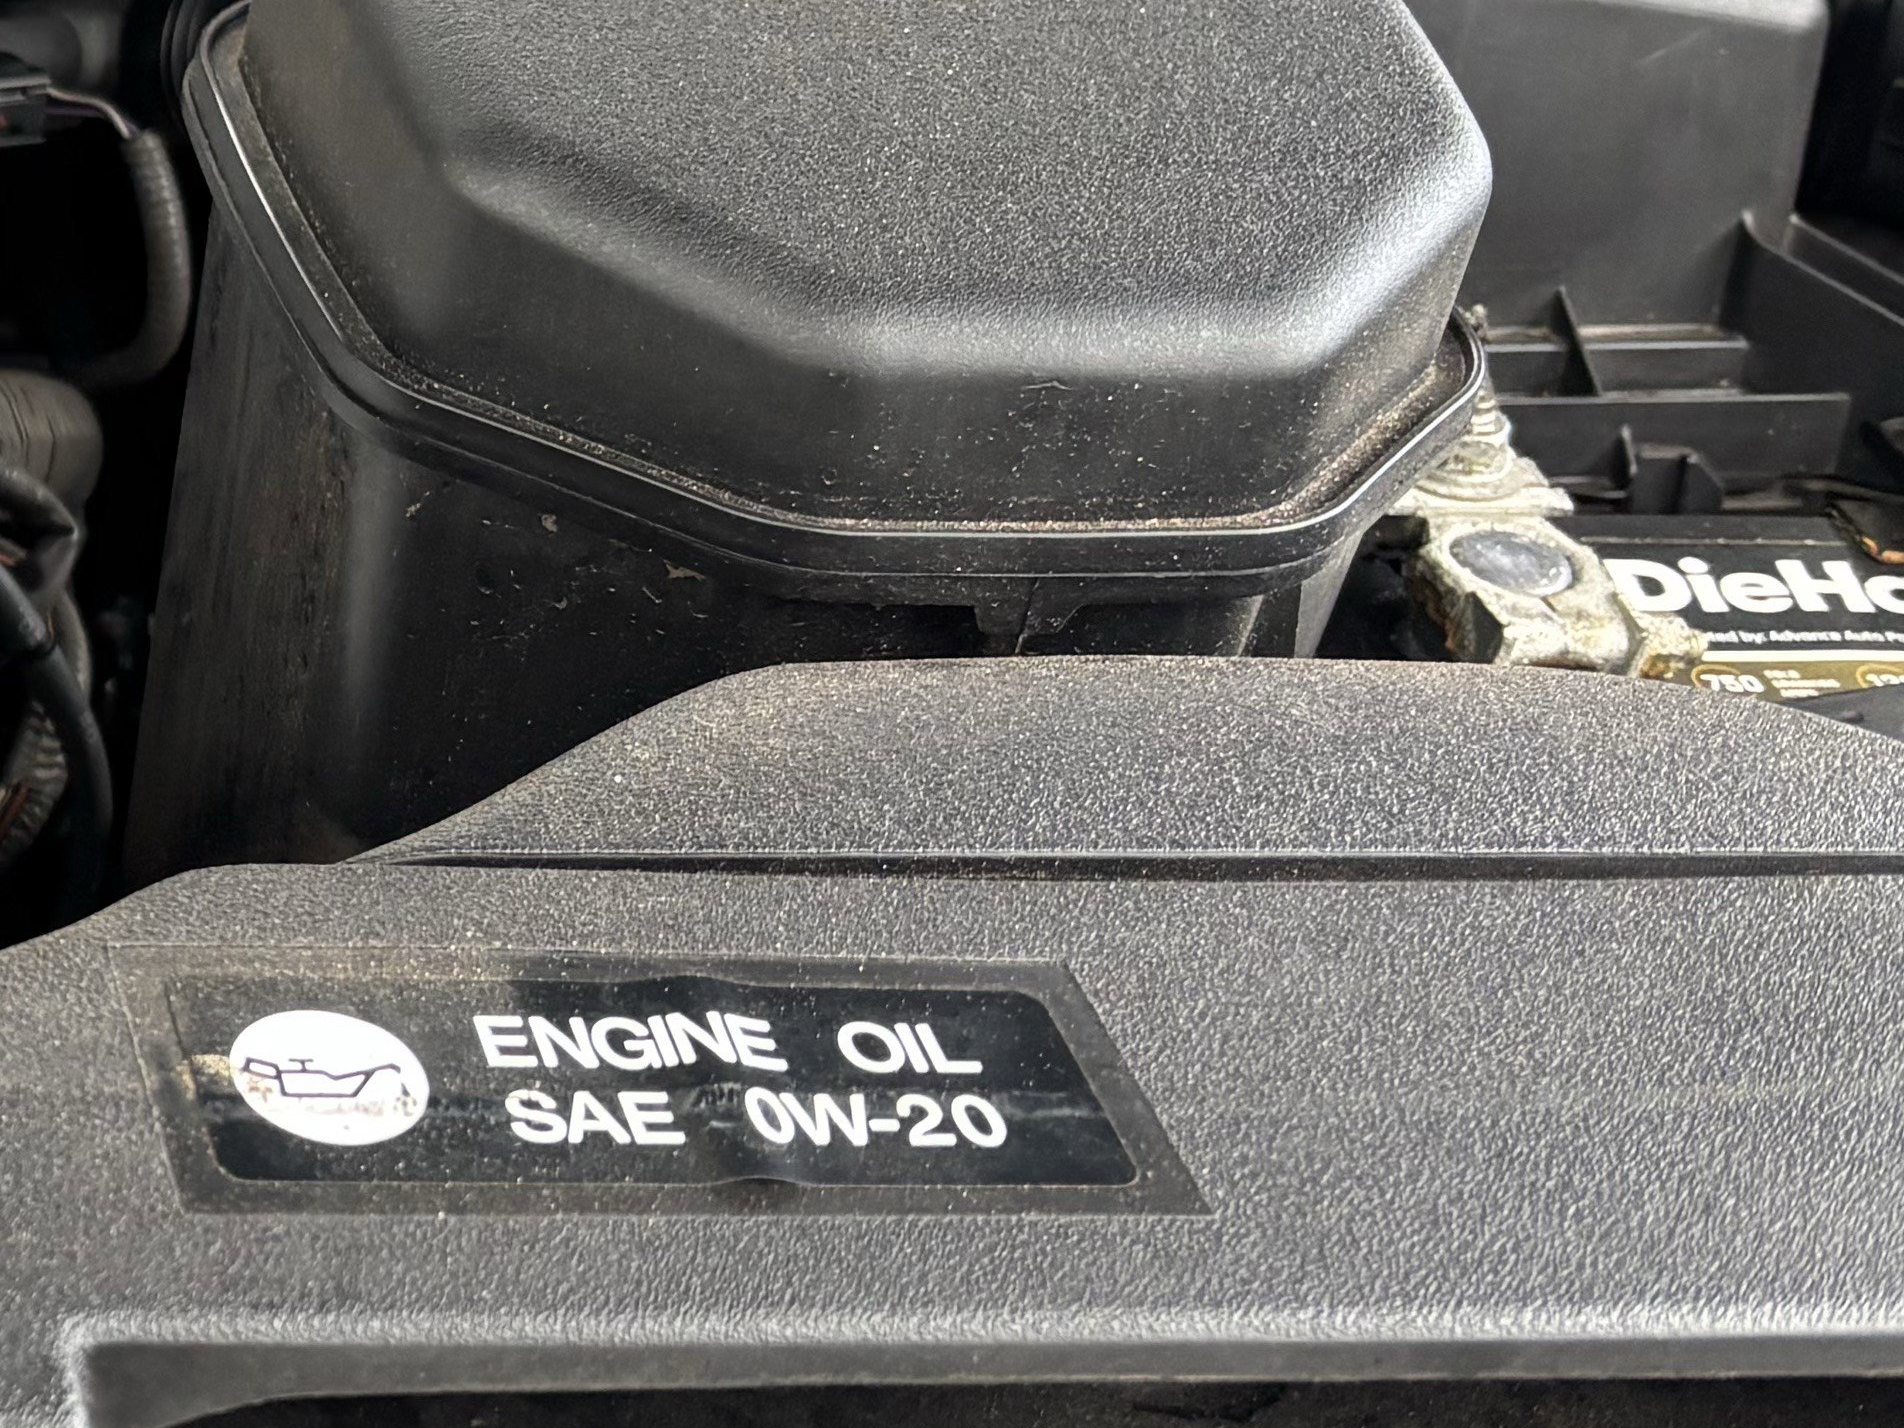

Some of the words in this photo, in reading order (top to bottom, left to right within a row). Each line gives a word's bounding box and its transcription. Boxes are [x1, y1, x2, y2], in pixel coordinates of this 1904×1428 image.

[472, 1010, 789, 1073] ENGINE
[836, 1019, 984, 1074] OIL
[504, 1087, 687, 1146] SAE
[743, 1085, 1009, 1149] 0W-20
